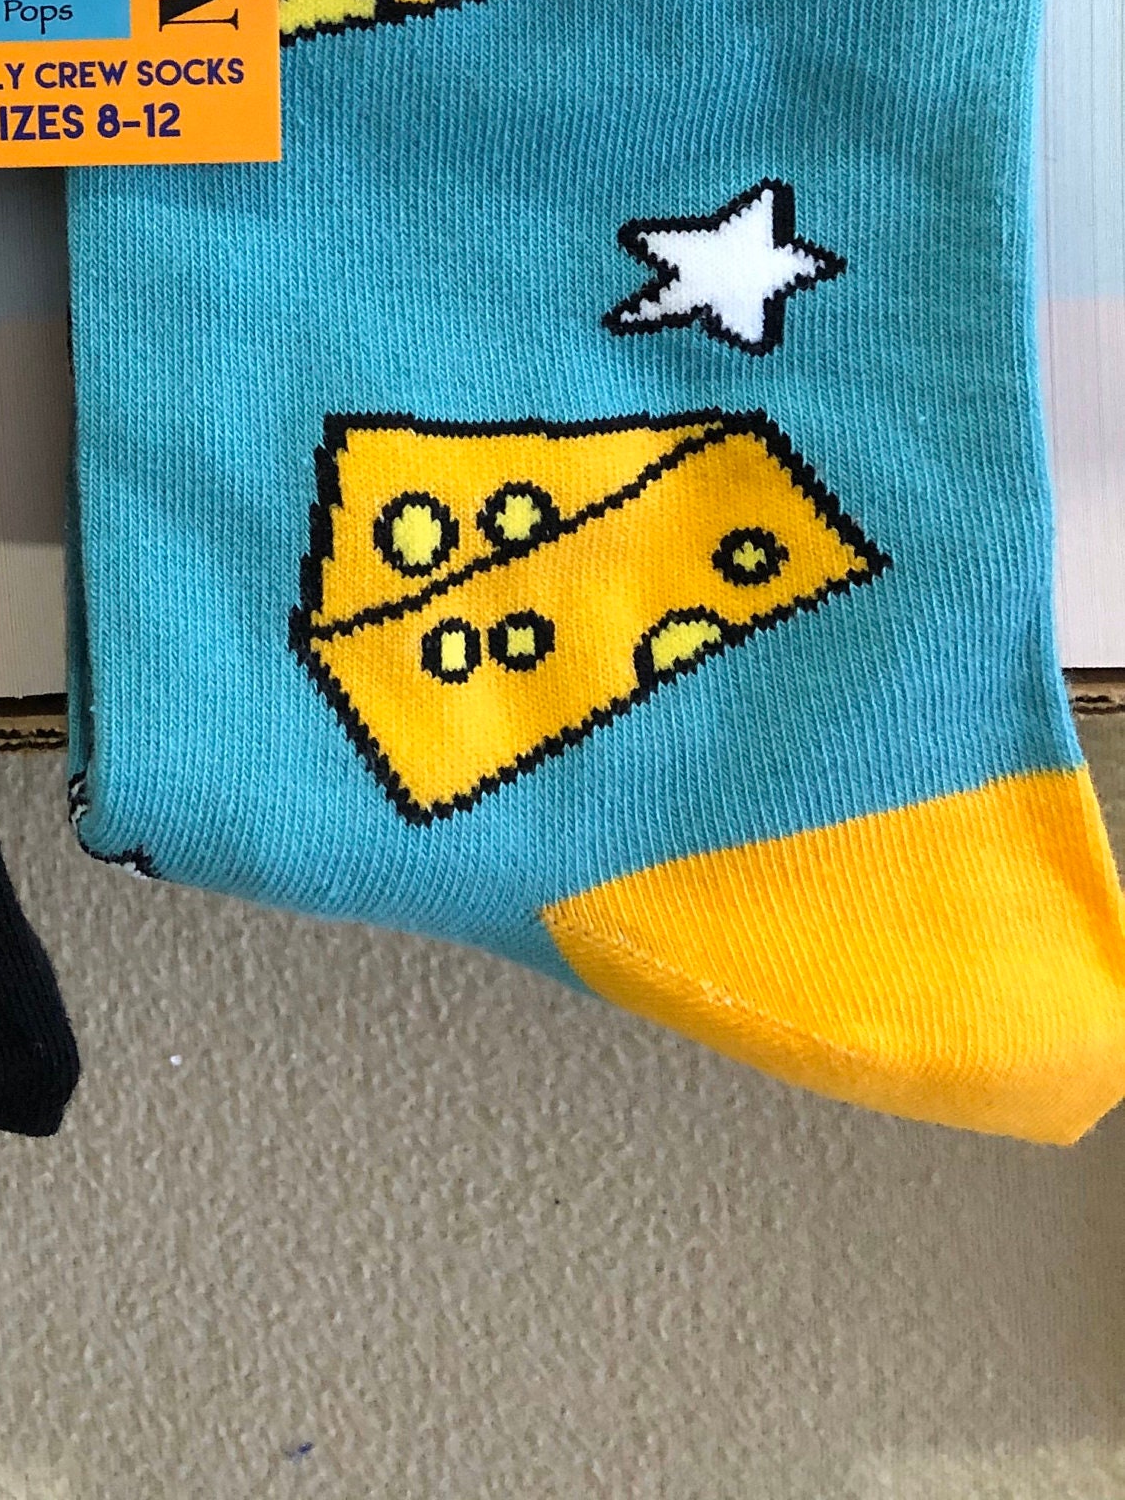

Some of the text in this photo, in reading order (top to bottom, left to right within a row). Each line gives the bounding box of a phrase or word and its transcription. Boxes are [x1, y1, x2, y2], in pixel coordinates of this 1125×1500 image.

[4, 0, 74, 35] Pops
[35, 60, 127, 89] CREW
[137, 57, 244, 87] SOCKS
[97, 102, 181, 139] 8-12
